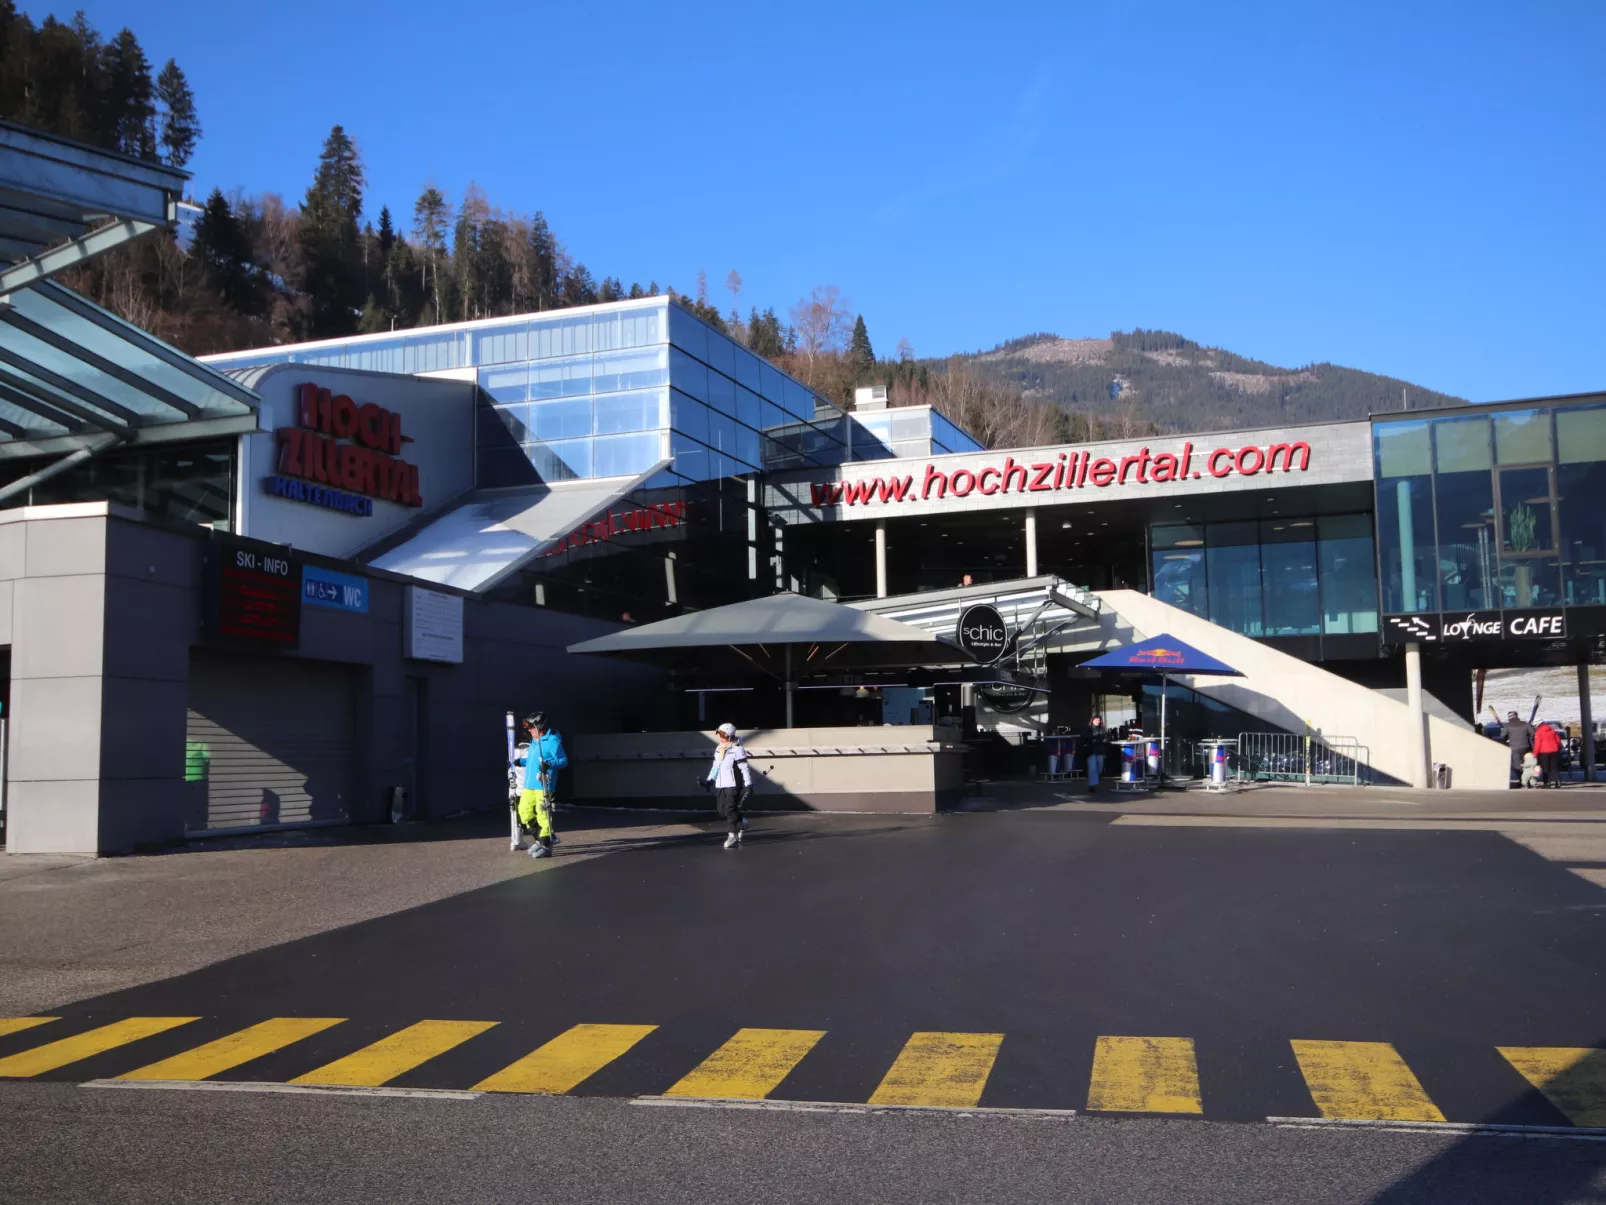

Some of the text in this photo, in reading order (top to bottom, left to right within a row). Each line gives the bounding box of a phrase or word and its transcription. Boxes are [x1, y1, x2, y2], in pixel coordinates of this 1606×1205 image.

[276, 427, 422, 507] ZILLERTAL
[809, 441, 1310, 509] www.hochzillertal.com
[268, 476, 373, 517] KALTENBACH
[236, 551, 256, 569] SKI
[263, 556, 289, 576] INFO
[343, 584, 363, 609] WC
[1510, 616, 1563, 635] CAFE
